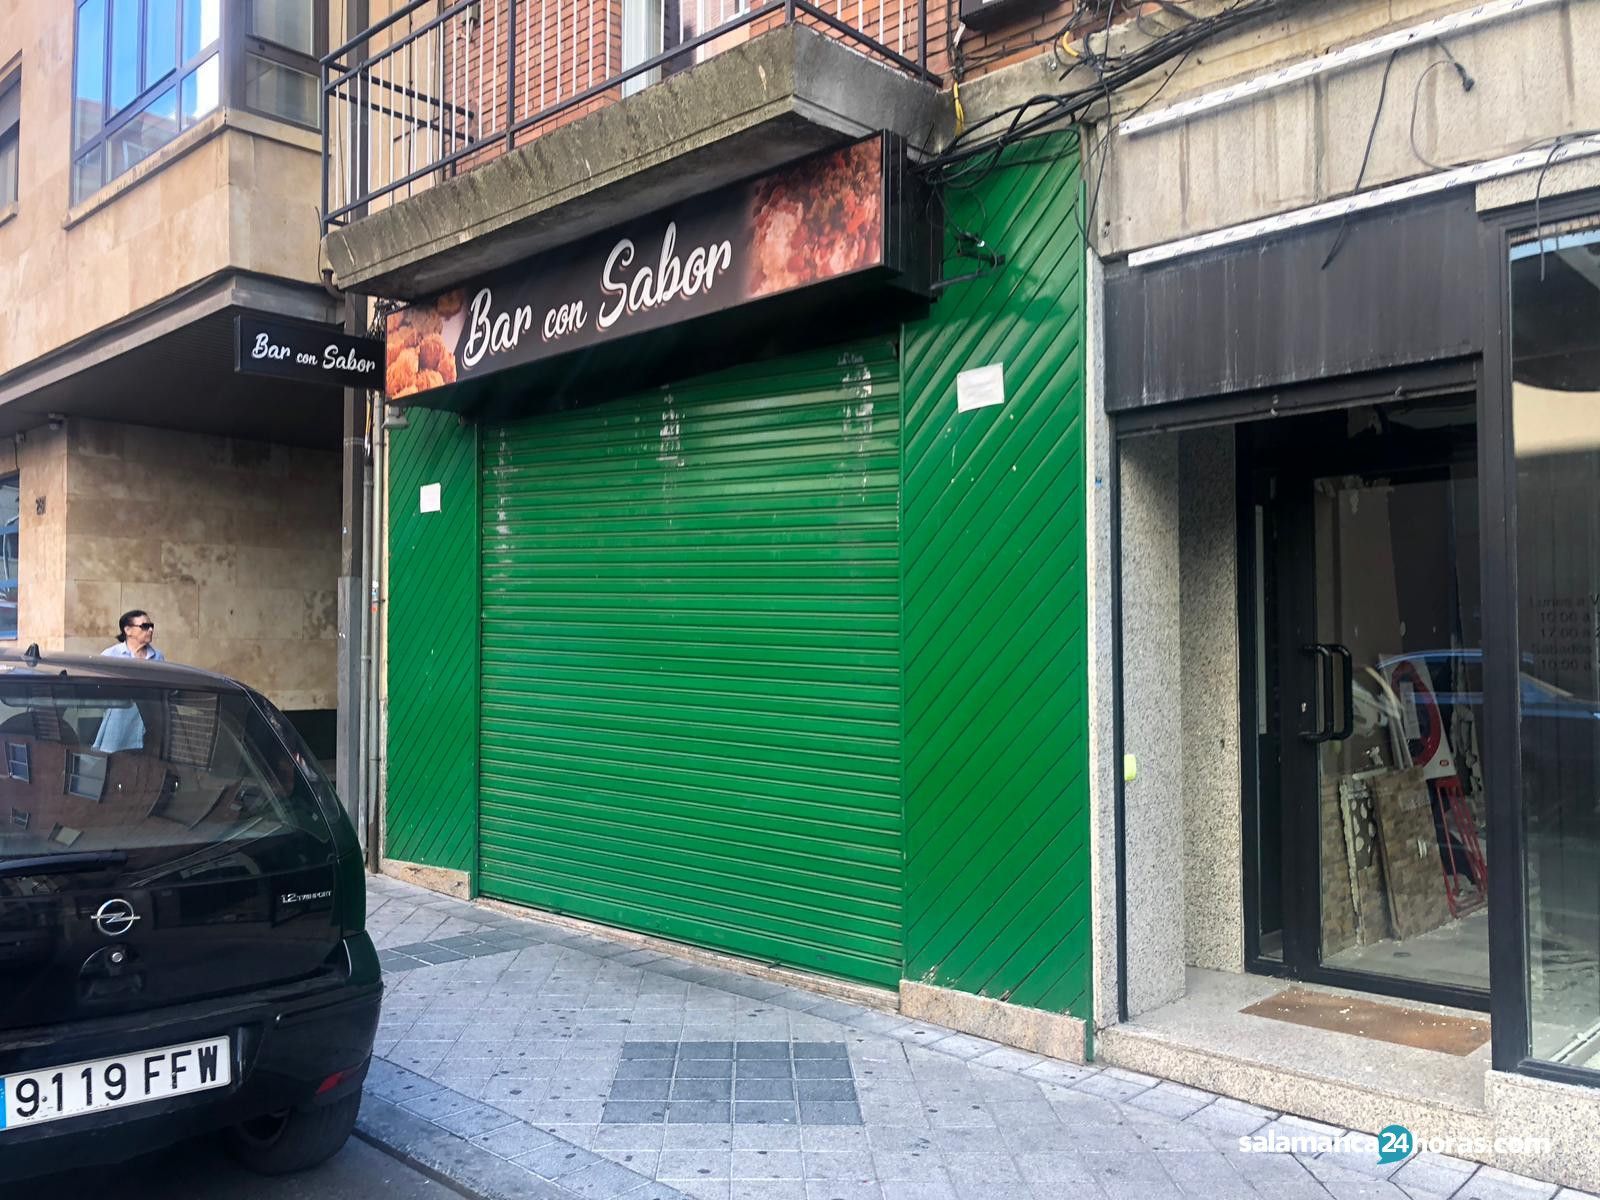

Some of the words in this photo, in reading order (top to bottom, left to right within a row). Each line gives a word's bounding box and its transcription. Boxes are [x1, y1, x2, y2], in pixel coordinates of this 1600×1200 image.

[462, 287, 532, 367] Bar
[542, 299, 587, 341] con
[597, 221, 732, 331] Sabor
[252, 333, 291, 359] Bar
[296, 352, 318, 365] con
[322, 344, 376, 373] Sabor
[16, 1063, 126, 1118] 9119
[144, 1045, 218, 1095] FFW
